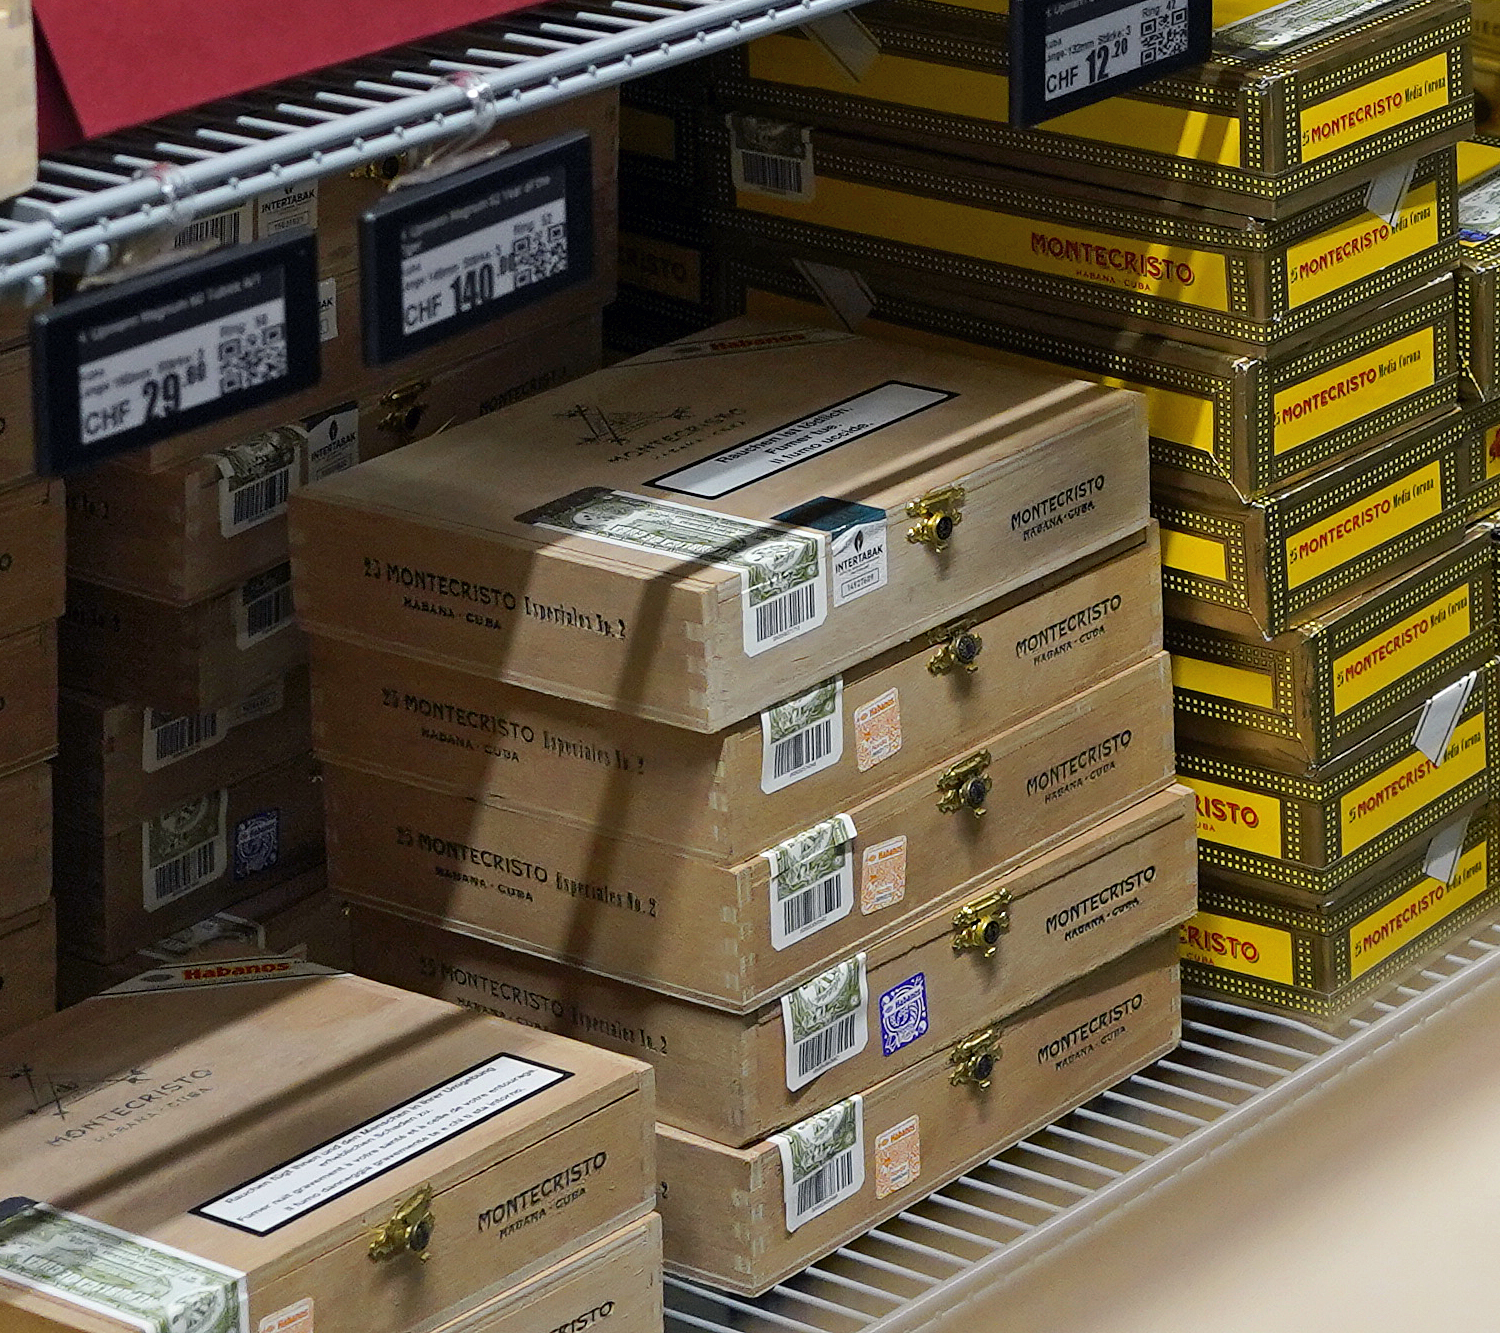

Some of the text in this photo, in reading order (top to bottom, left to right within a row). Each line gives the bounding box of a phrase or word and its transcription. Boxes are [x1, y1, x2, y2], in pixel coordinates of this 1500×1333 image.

[1046, 65, 1079, 93] CHF
[1310, 71, 1447, 144] MONTECRISTO Media Corona
[261, 187, 317, 213] INTERTABAK
[1030, 230, 1196, 287] MONTECRISTO
[1298, 224, 1390, 280] MONTECRISTO
[1281, 349, 1421, 425] MONTECRISTO Media Corona
[86, 399, 131, 435] CHF
[766, 432, 813, 456] Fumer
[783, 443, 820, 463] fumo
[1010, 473, 1107, 533] MONTECRISTO
[1299, 478, 1435, 560] MONTECRISTO Media Corona
[387, 566, 516, 611] MONTECRISTO
[835, 545, 883, 574] INTERTABAK
[1014, 594, 1124, 659] MONTECRISTO
[1345, 619, 1429, 682] MONTECRISTO
[1025, 729, 1133, 798] MONTECRISTO
[418, 833, 548, 883] MONTECRISTO
[1044, 864, 1157, 935] MONTECRISTO
[1363, 885, 1444, 953] MONTECRISTO
[183, 958, 290, 983] Habanos
[1036, 992, 1144, 1065] MONTECRISTO
[476, 1151, 608, 1232] MONTECRISTO
